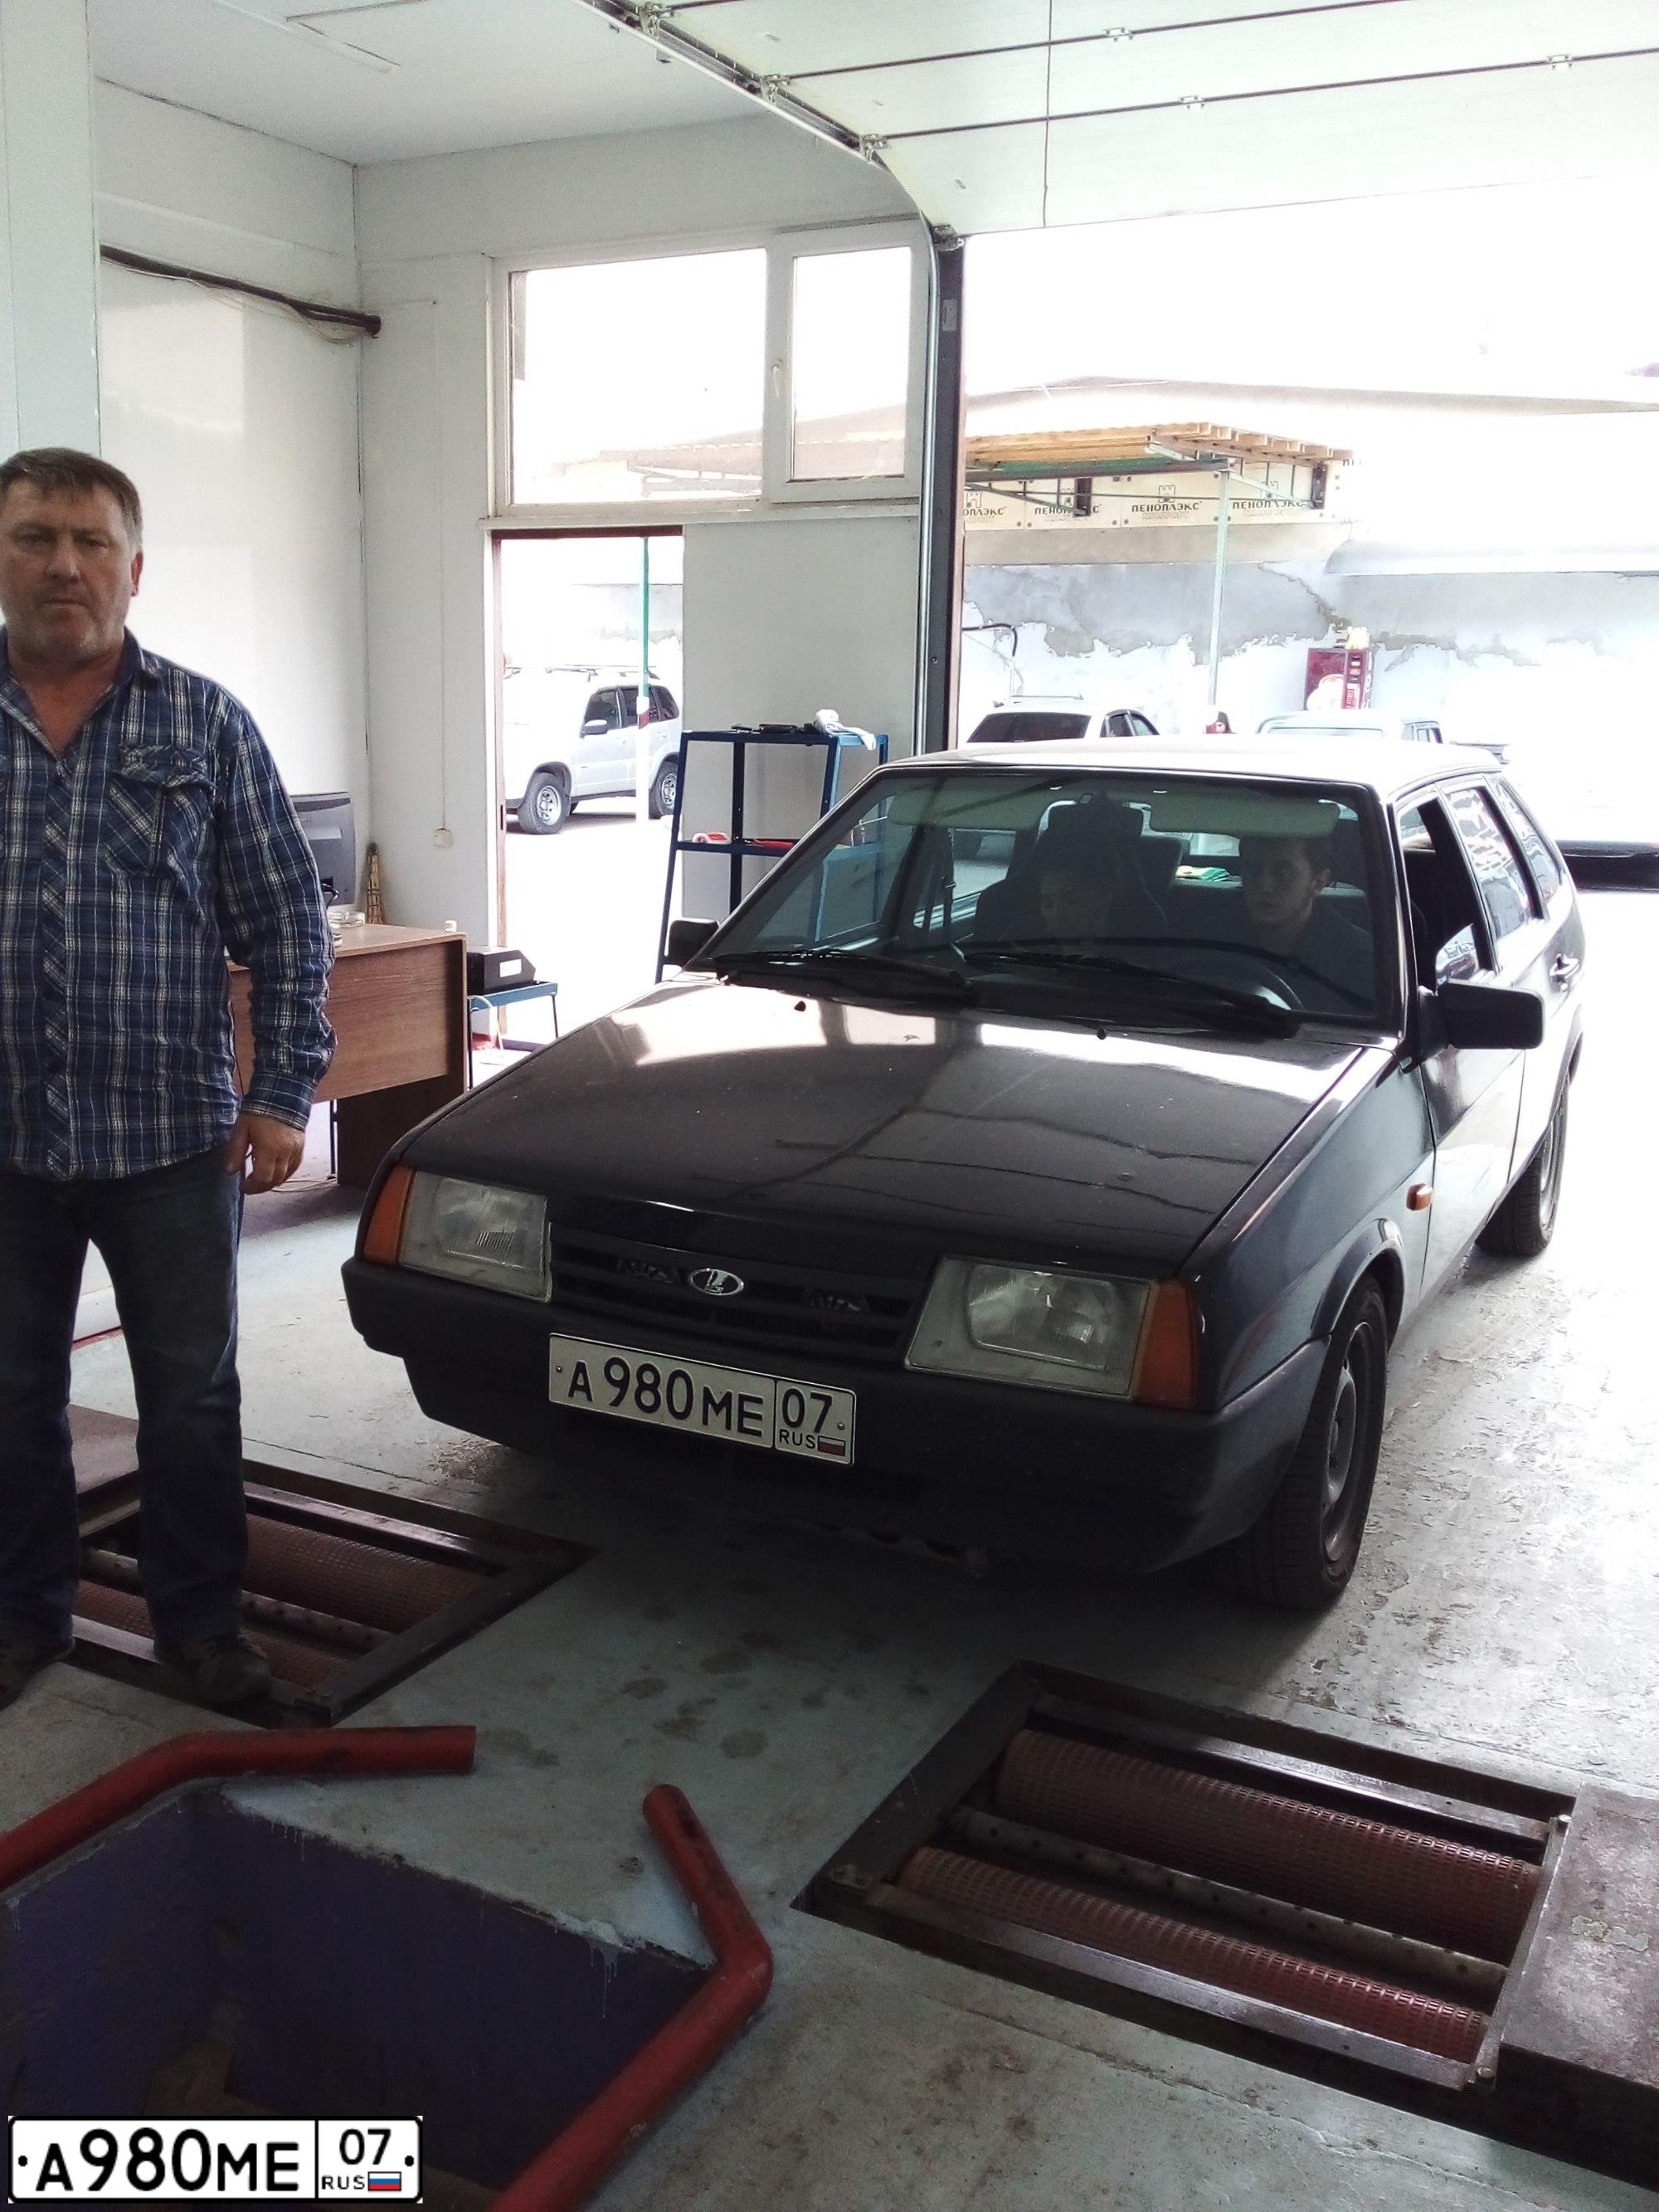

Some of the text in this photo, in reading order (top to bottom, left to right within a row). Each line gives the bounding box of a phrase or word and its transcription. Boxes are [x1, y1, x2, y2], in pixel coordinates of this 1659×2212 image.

[1131, 502, 1199, 513] ПЕНОПЛЭКС
[781, 1388, 833, 1433] 07
[779, 1429, 816, 1449] RUS
